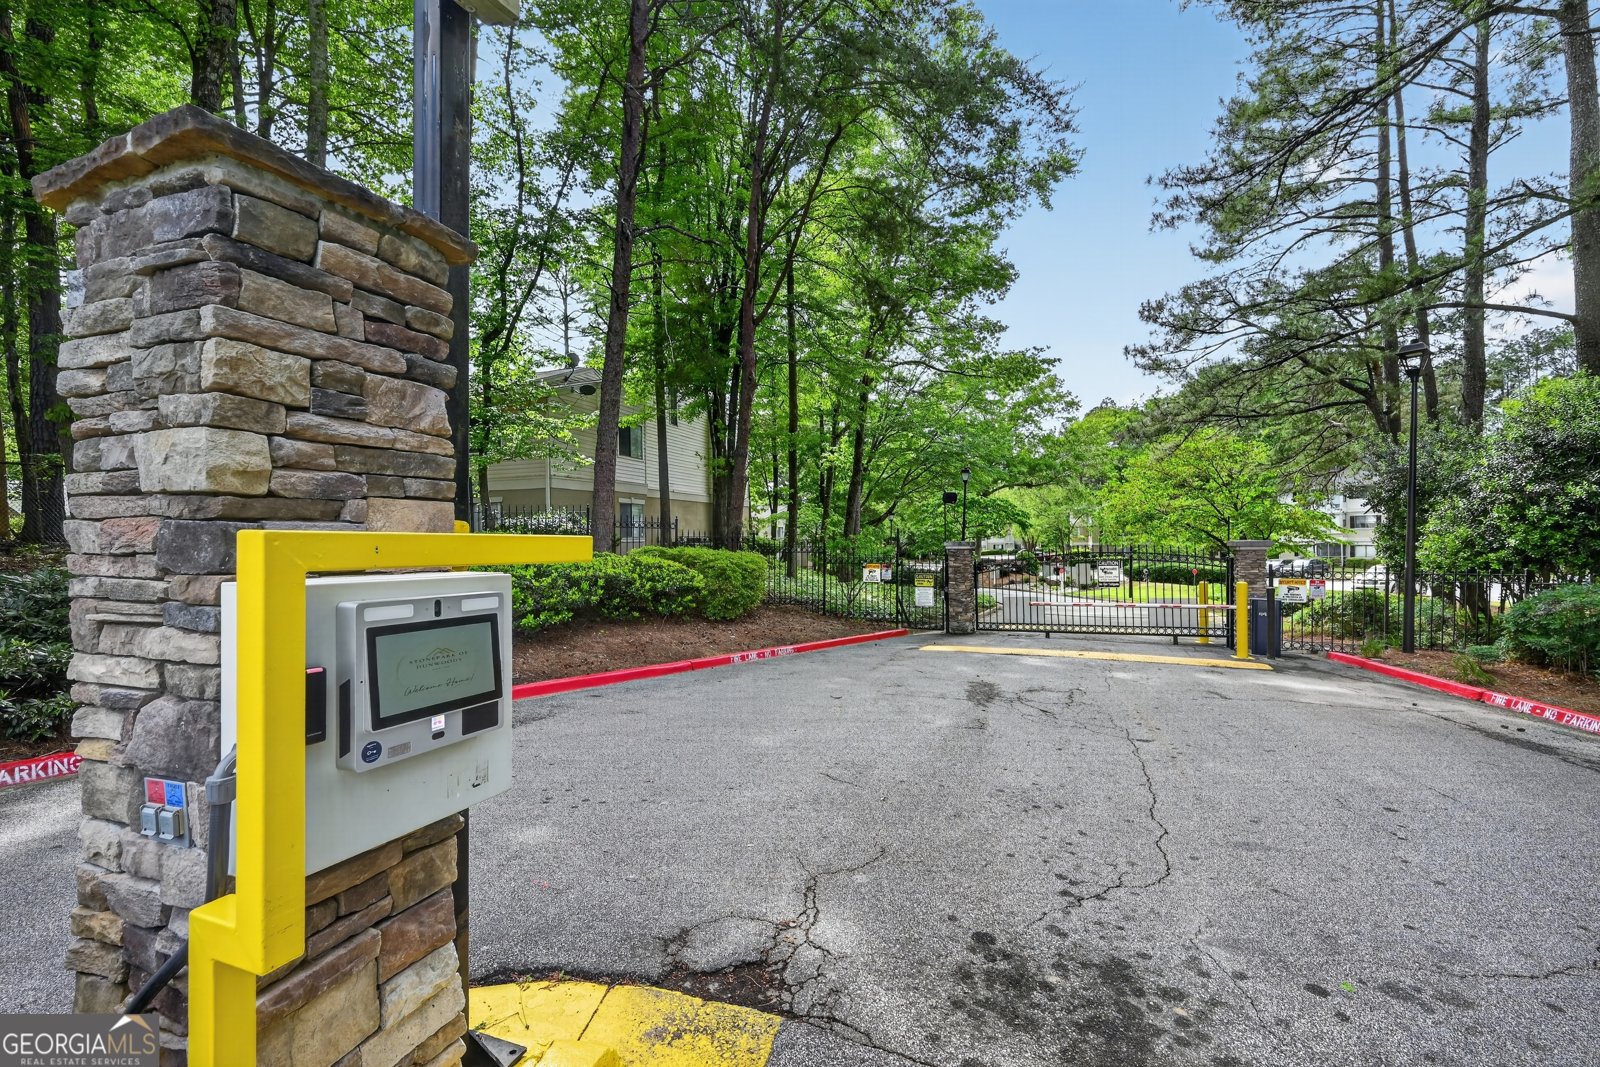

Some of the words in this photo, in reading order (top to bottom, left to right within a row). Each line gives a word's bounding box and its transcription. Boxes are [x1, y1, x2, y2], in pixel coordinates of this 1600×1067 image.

[1491, 693, 1508, 705] FIRE
[1511, 699, 1533, 713] LANE
[1543, 708, 1559, 720] NO
[1563, 713, 1600, 732] PARKIN
[0, 756, 82, 784] ARKING
